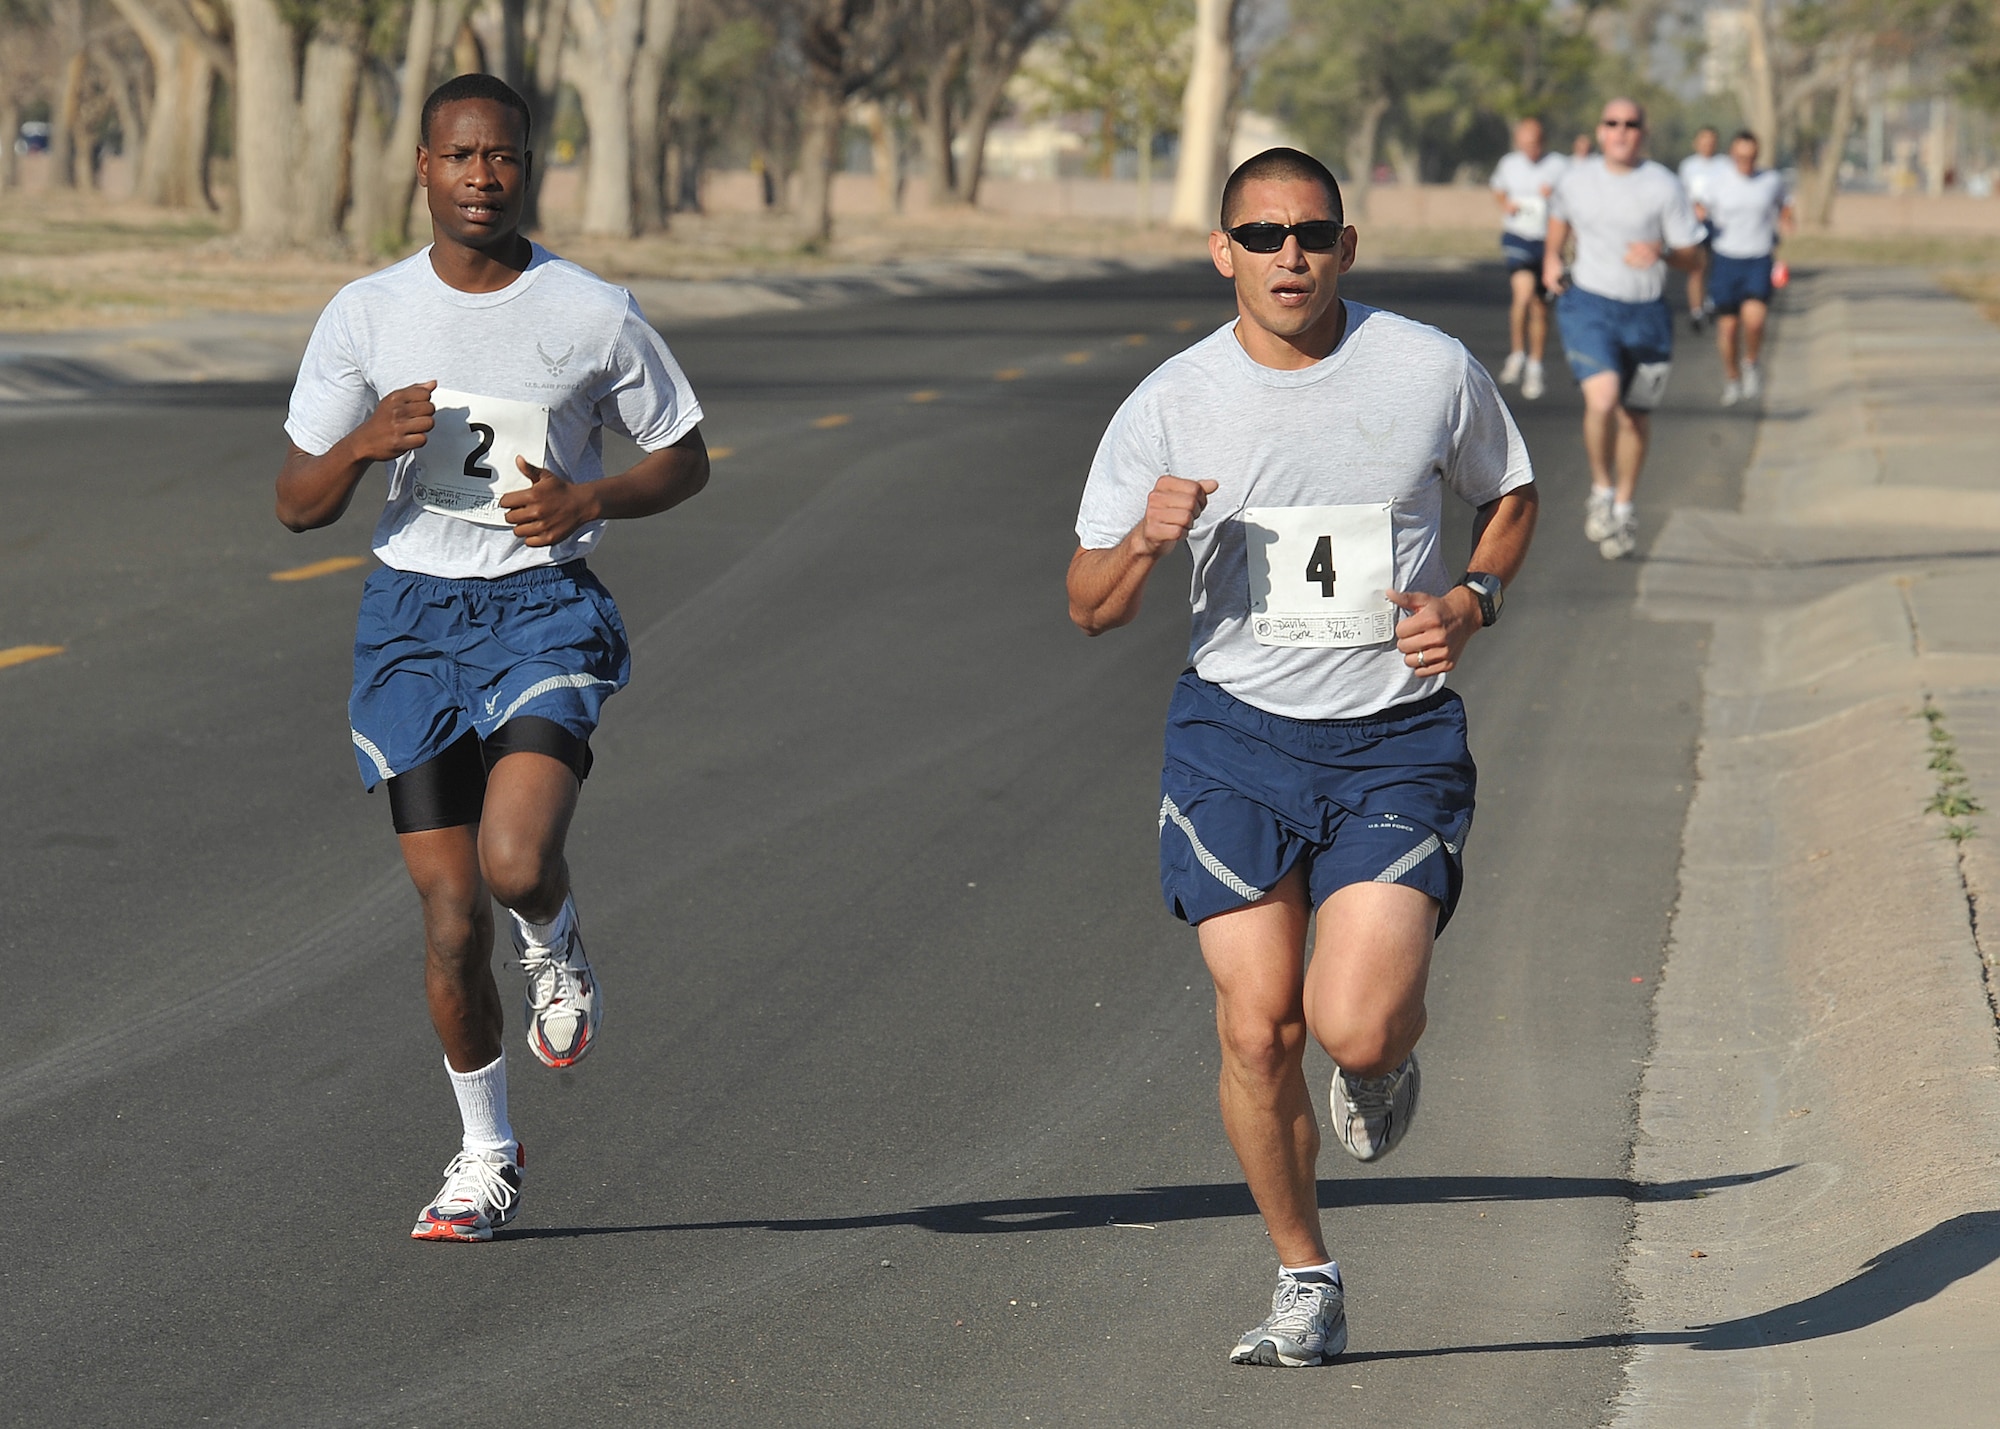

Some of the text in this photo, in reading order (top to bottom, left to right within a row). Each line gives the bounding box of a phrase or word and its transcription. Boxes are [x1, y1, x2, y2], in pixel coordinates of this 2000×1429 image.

[556, 383, 580, 391] FORCE
[464, 422, 495, 479] 2
[1305, 535, 1336, 598] 4
[1392, 823, 1414, 832] FORCE
